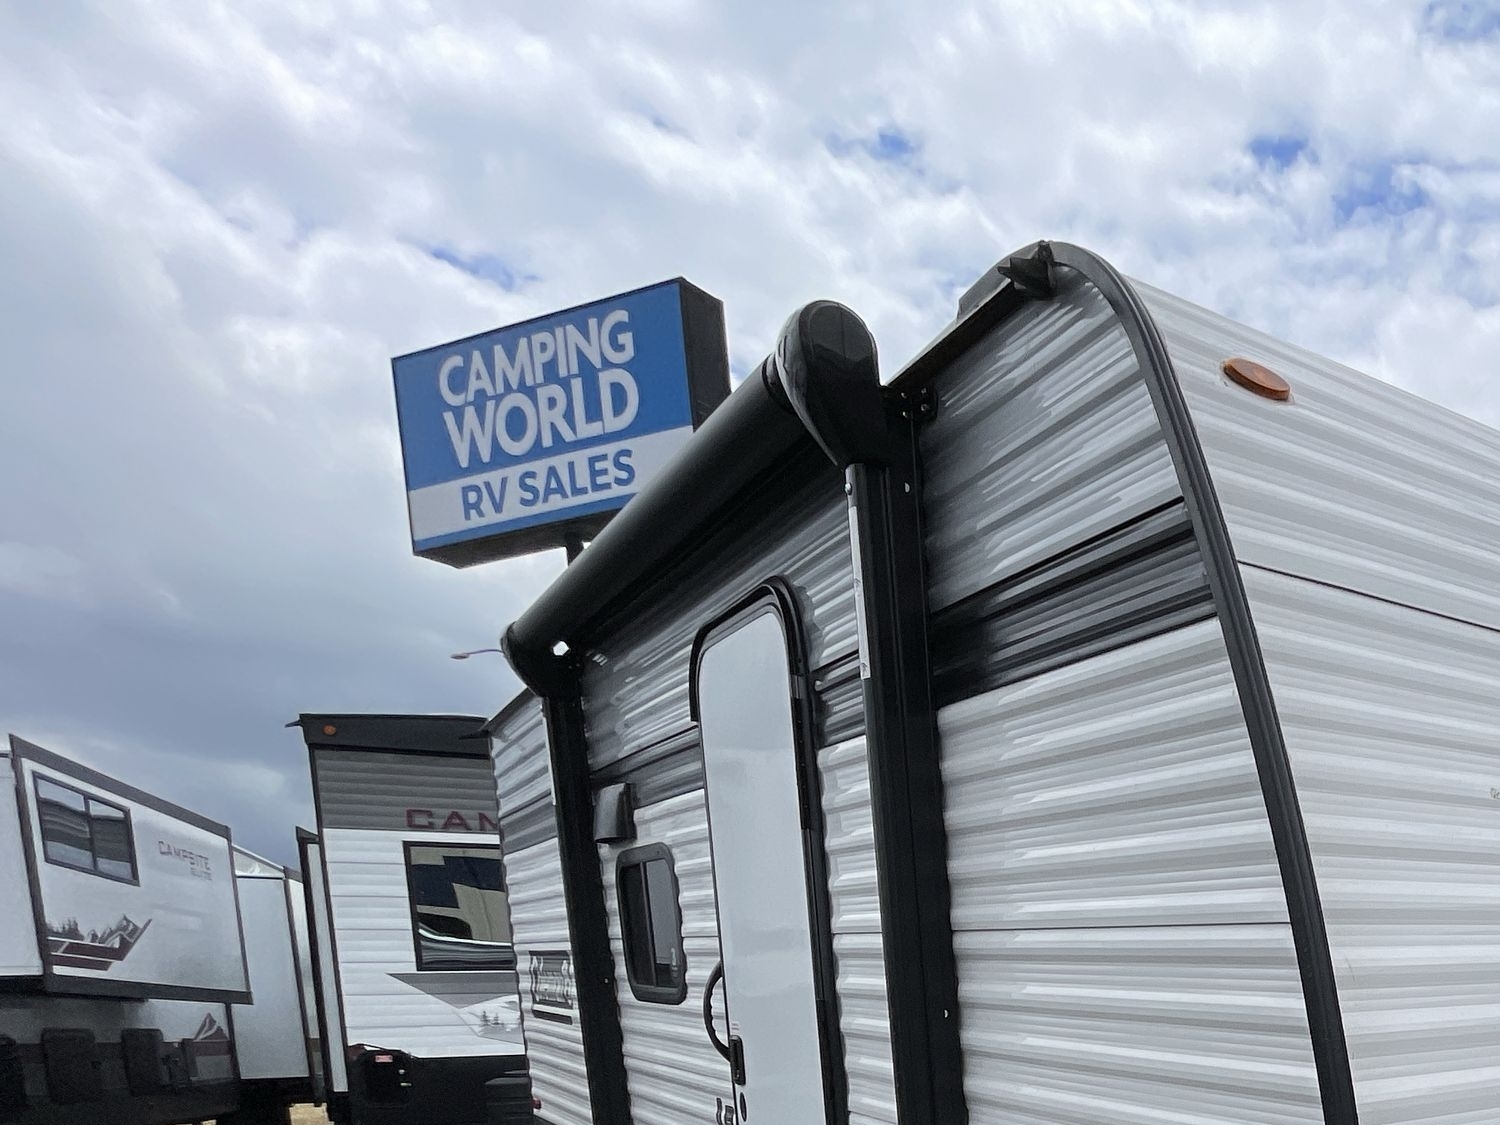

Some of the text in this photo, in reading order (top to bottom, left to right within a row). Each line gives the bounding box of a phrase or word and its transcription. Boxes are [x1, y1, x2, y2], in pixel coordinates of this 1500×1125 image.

[439, 309, 636, 407] CAMPING
[442, 368, 640, 469] WORLD
[461, 449, 636, 521] RV SALES
